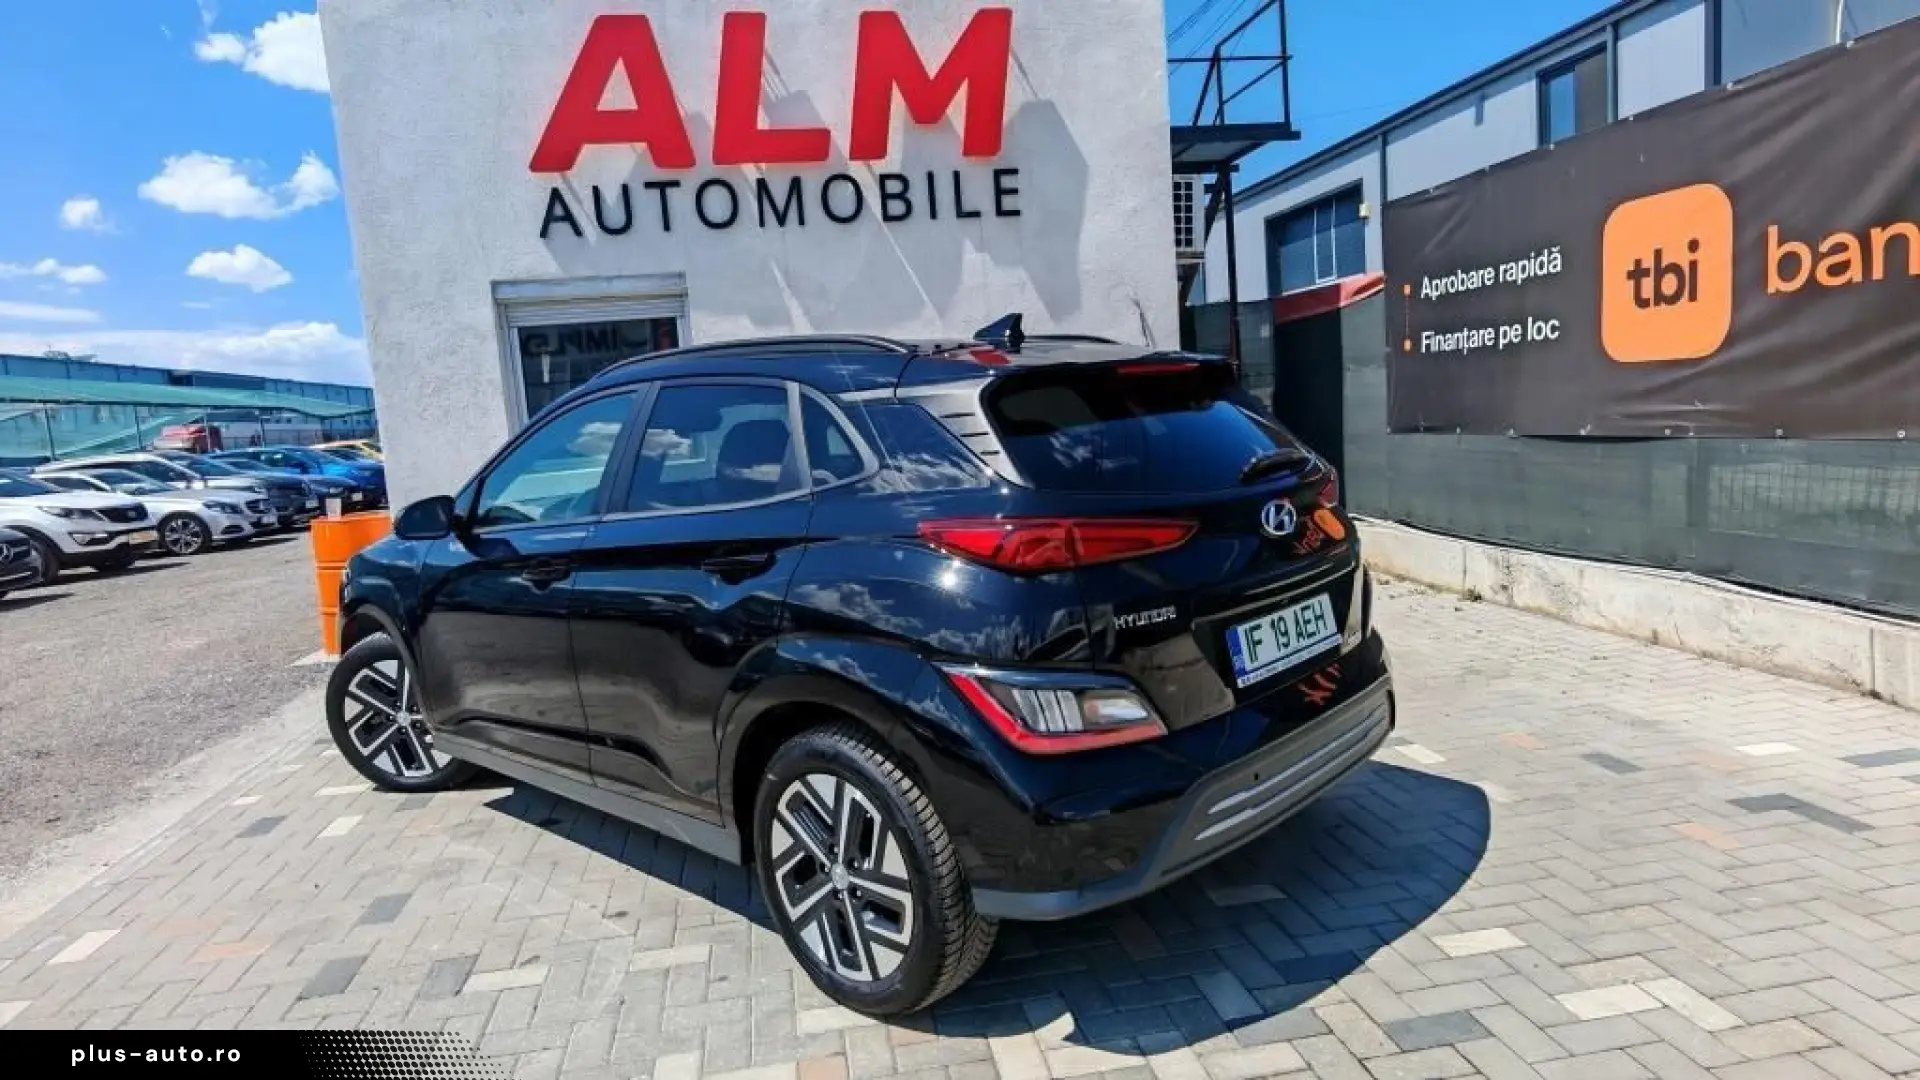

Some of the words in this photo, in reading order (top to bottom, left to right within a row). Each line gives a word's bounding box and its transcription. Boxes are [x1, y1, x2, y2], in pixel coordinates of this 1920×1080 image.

[529, 7, 1013, 173] ALM
[539, 168, 1022, 239] AUTOMOBILE
[1420, 266, 1495, 300] Aprobare
[1500, 246, 1563, 286] rapidă
[1626, 238, 1700, 310] tbi
[1766, 221, 1920, 295] ban
[1420, 327, 1495, 356] Finanțare
[1500, 322, 1522, 350] pe
[1527, 316, 1561, 342] loc
[1113, 605, 1177, 630] HYUNDAI
[1244, 623, 1263, 664] IF
[1270, 614, 1291, 652] 19
[1293, 599, 1328, 643] AEH
